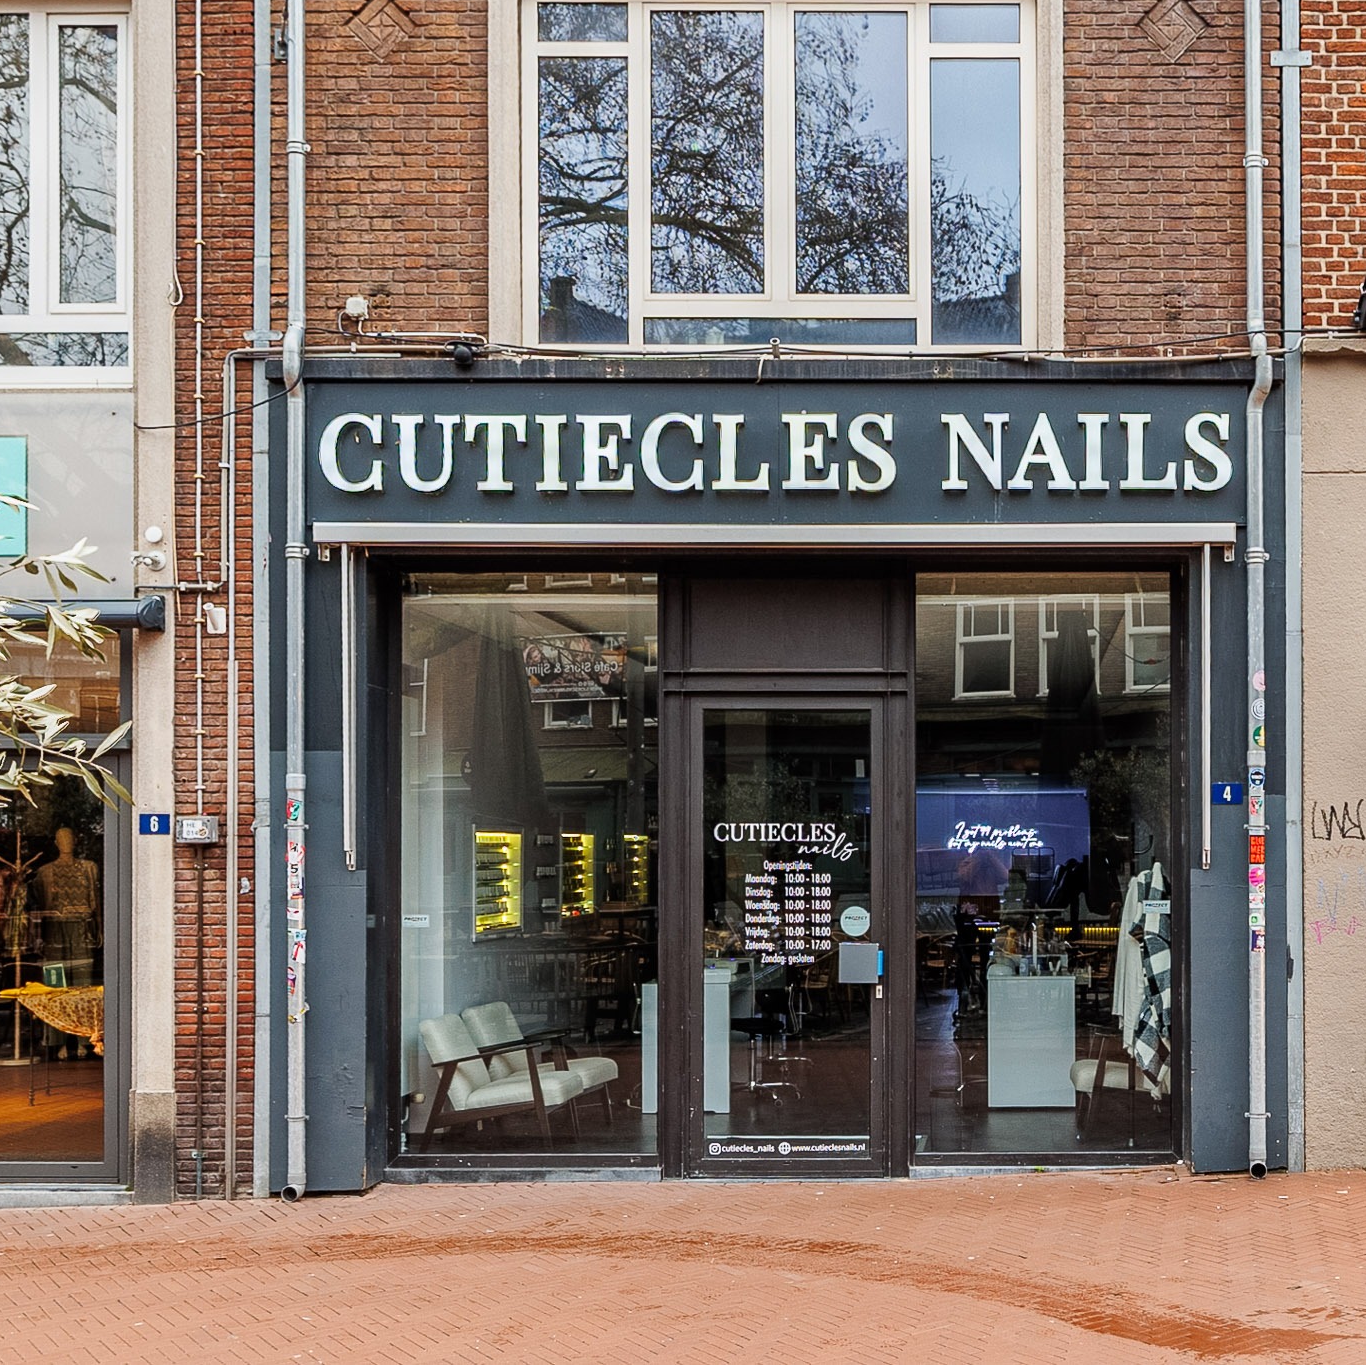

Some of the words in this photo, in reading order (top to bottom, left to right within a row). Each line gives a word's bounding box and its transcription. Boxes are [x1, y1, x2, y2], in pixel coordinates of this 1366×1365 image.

[317, 411, 898, 494] CUTIECLES
[939, 410, 1234, 492] NAILS
[1222, 785, 1232, 802] 4
[149, 815, 160, 833] 6
[713, 822, 837, 843] CUTIECLES
[797, 832, 859, 862] nails
[763, 860, 813, 872] Openingstijden:
[745, 873, 777, 885] Maandag:
[784, 873, 805, 883] 10:00
[811, 873, 832, 883] 18:00
[745, 886, 773, 898] Dinsdag:
[784, 886, 805, 897] 10:00
[811, 886, 832, 897] 18:00
[745, 899, 780, 912] Woensdag:
[784, 899, 805, 910] 10:00
[811, 899, 832, 910] 18:00
[745, 913, 782, 926] Donderdag:
[784, 913, 805, 924] 10:00
[811, 913, 832, 924] 18:00
[745, 926, 770, 939] Vrijdag:
[784, 926, 805, 937] 10:00
[811, 926, 832, 937] 18:00
[745, 939, 775, 952] Zaterdag:
[784, 939, 805, 950] 10:00
[811, 939, 832, 950] 17:00
[761, 953, 787, 965] Zondag:
[788, 953, 815, 965] gesloten
[721, 1142, 775, 1154] cutiecles_nails
[791, 1142, 866, 1153] www.cutieclesnails.nl
